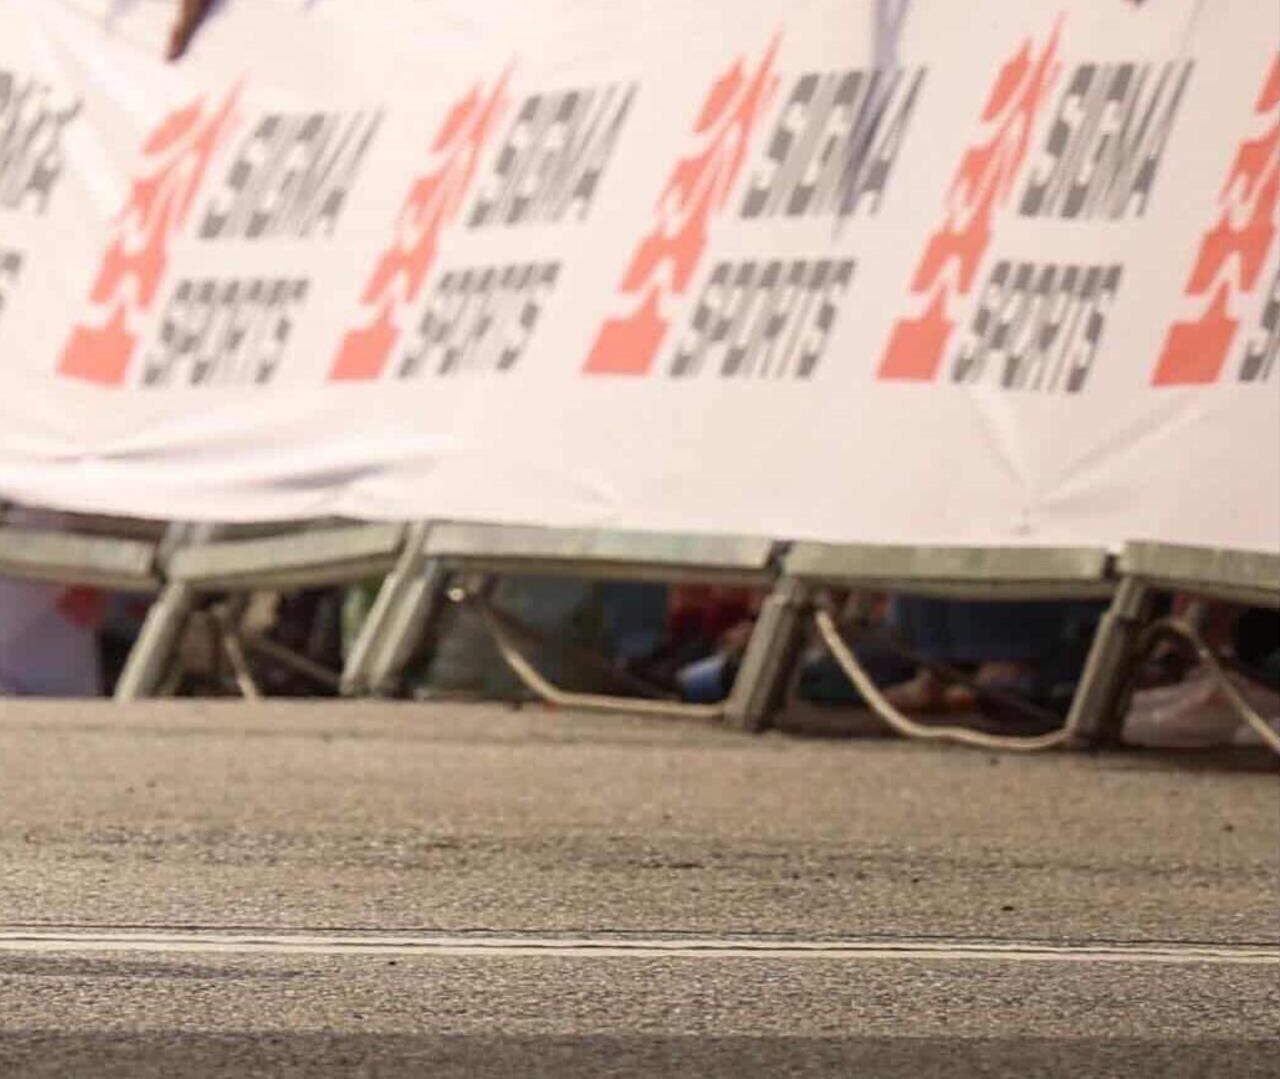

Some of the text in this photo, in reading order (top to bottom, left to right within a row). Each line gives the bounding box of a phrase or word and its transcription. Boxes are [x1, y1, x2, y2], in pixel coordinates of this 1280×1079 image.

[198, 104, 386, 240] SIGMA
[465, 80, 640, 229] SIGMA
[740, 65, 929, 219] SIGMA
[1019, 59, 1196, 219] SIGMA
[143, 277, 310, 386] SPORTS
[398, 260, 563, 379] SPORTS
[670, 259, 855, 378] SPORTS
[952, 260, 1124, 394] SPORTS
